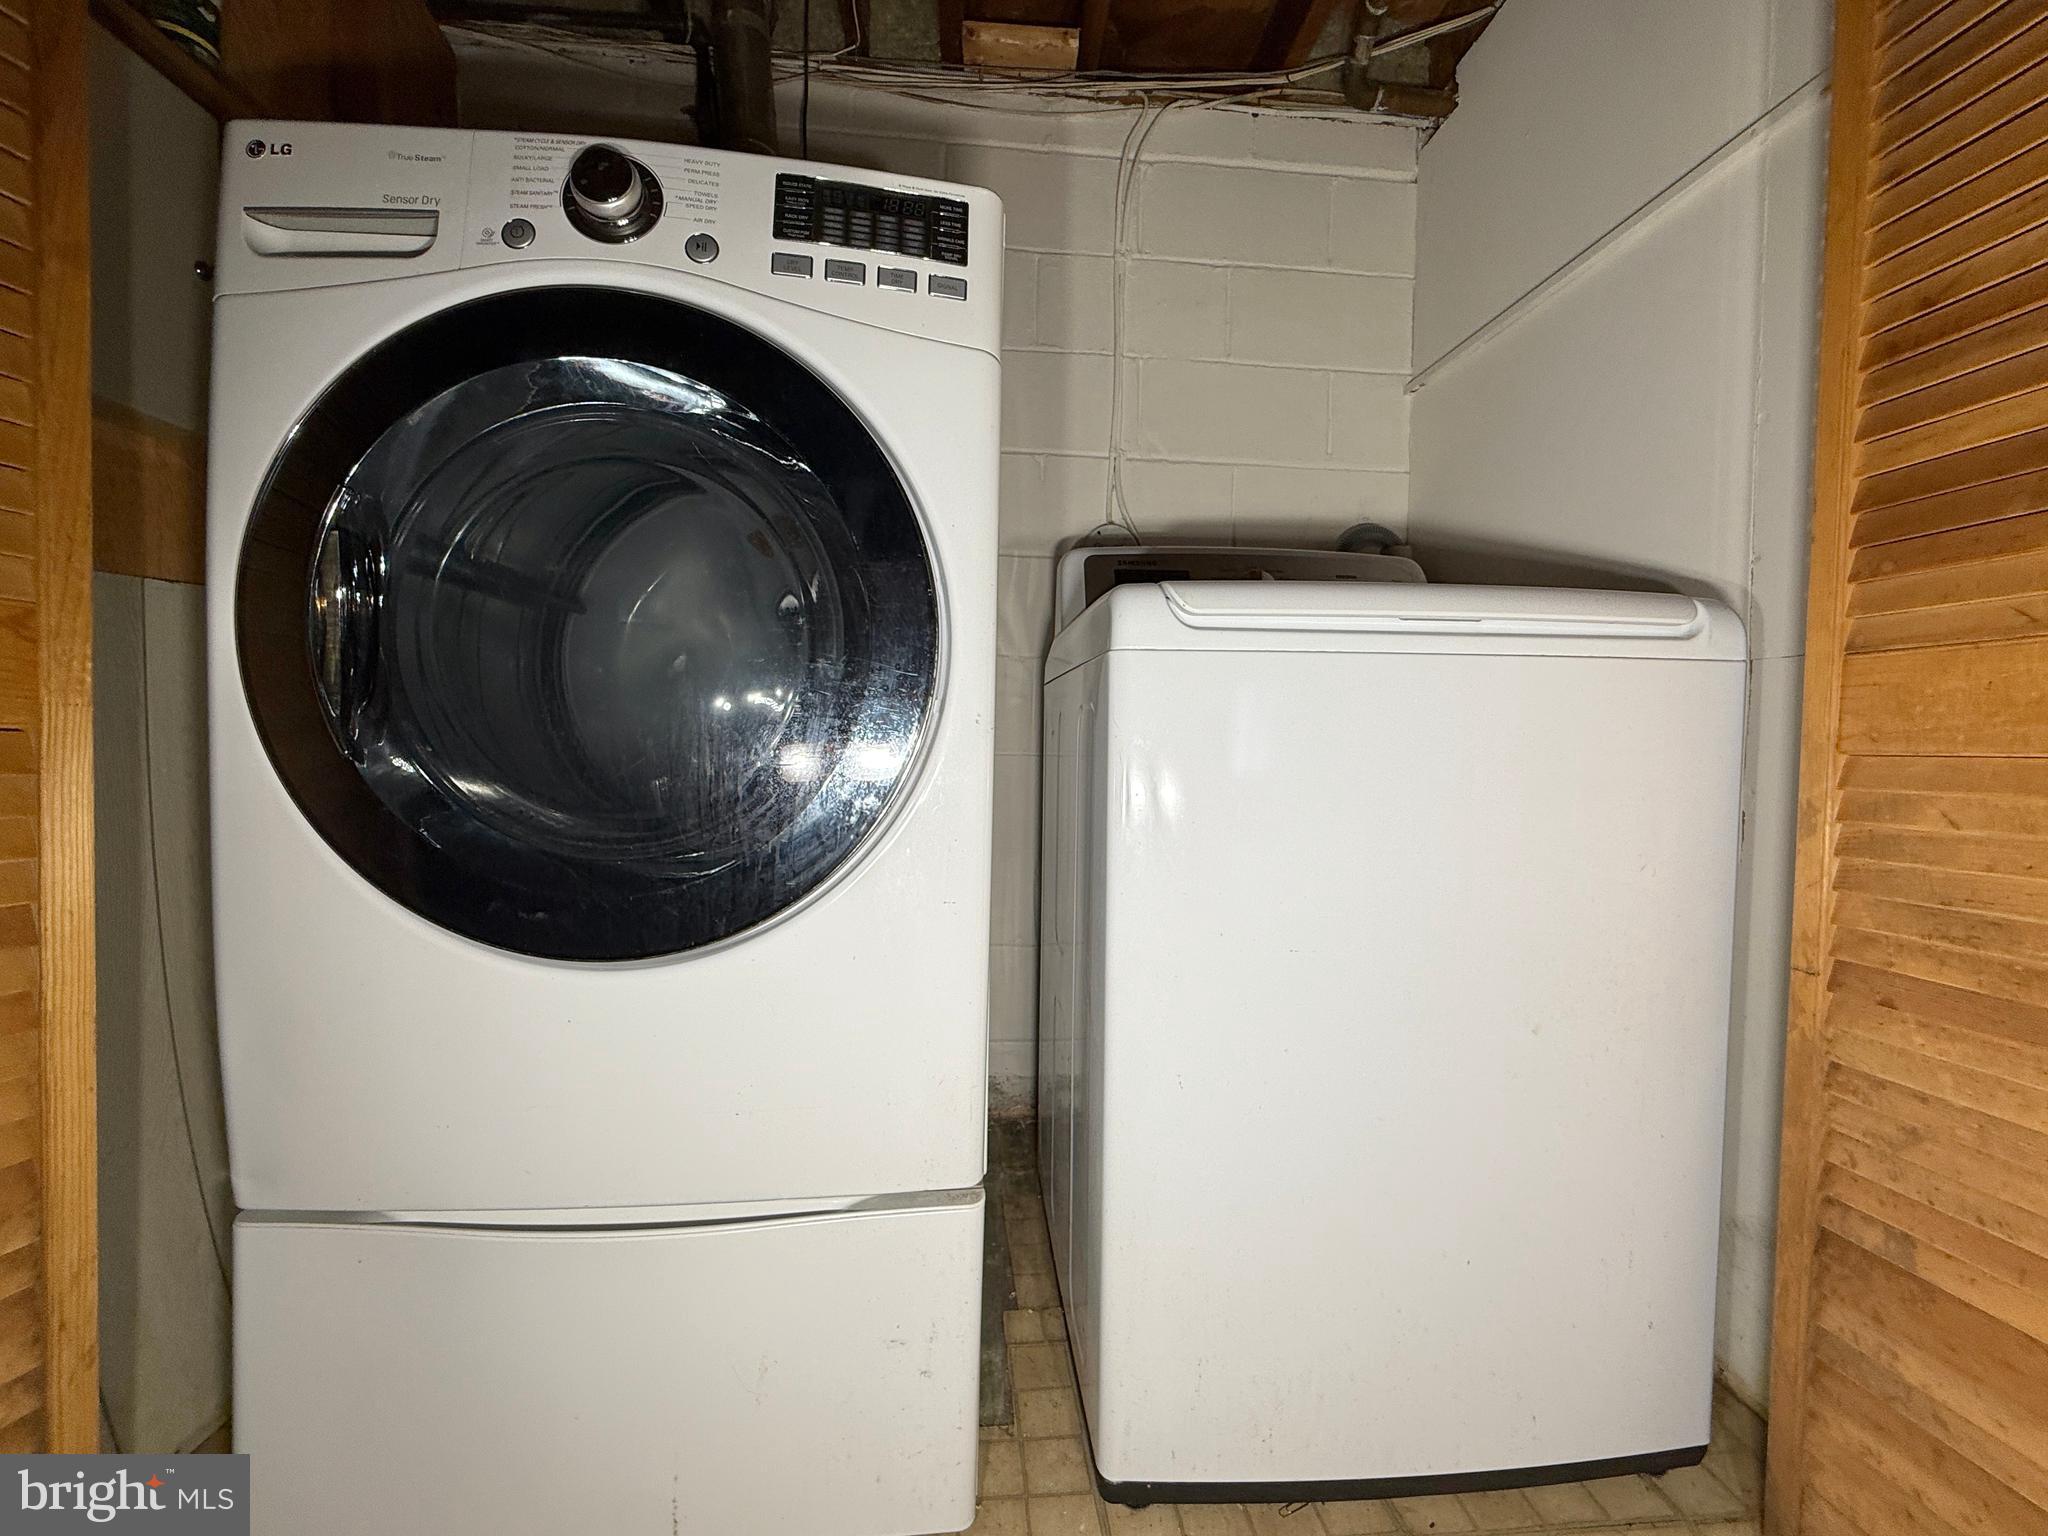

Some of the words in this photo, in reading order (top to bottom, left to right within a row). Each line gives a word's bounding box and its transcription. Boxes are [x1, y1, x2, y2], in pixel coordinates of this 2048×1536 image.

[270, 143, 292, 155] LG
[397, 153, 413, 161] True
[382, 193, 418, 204] Sensor
[421, 195, 441, 207] Dry
